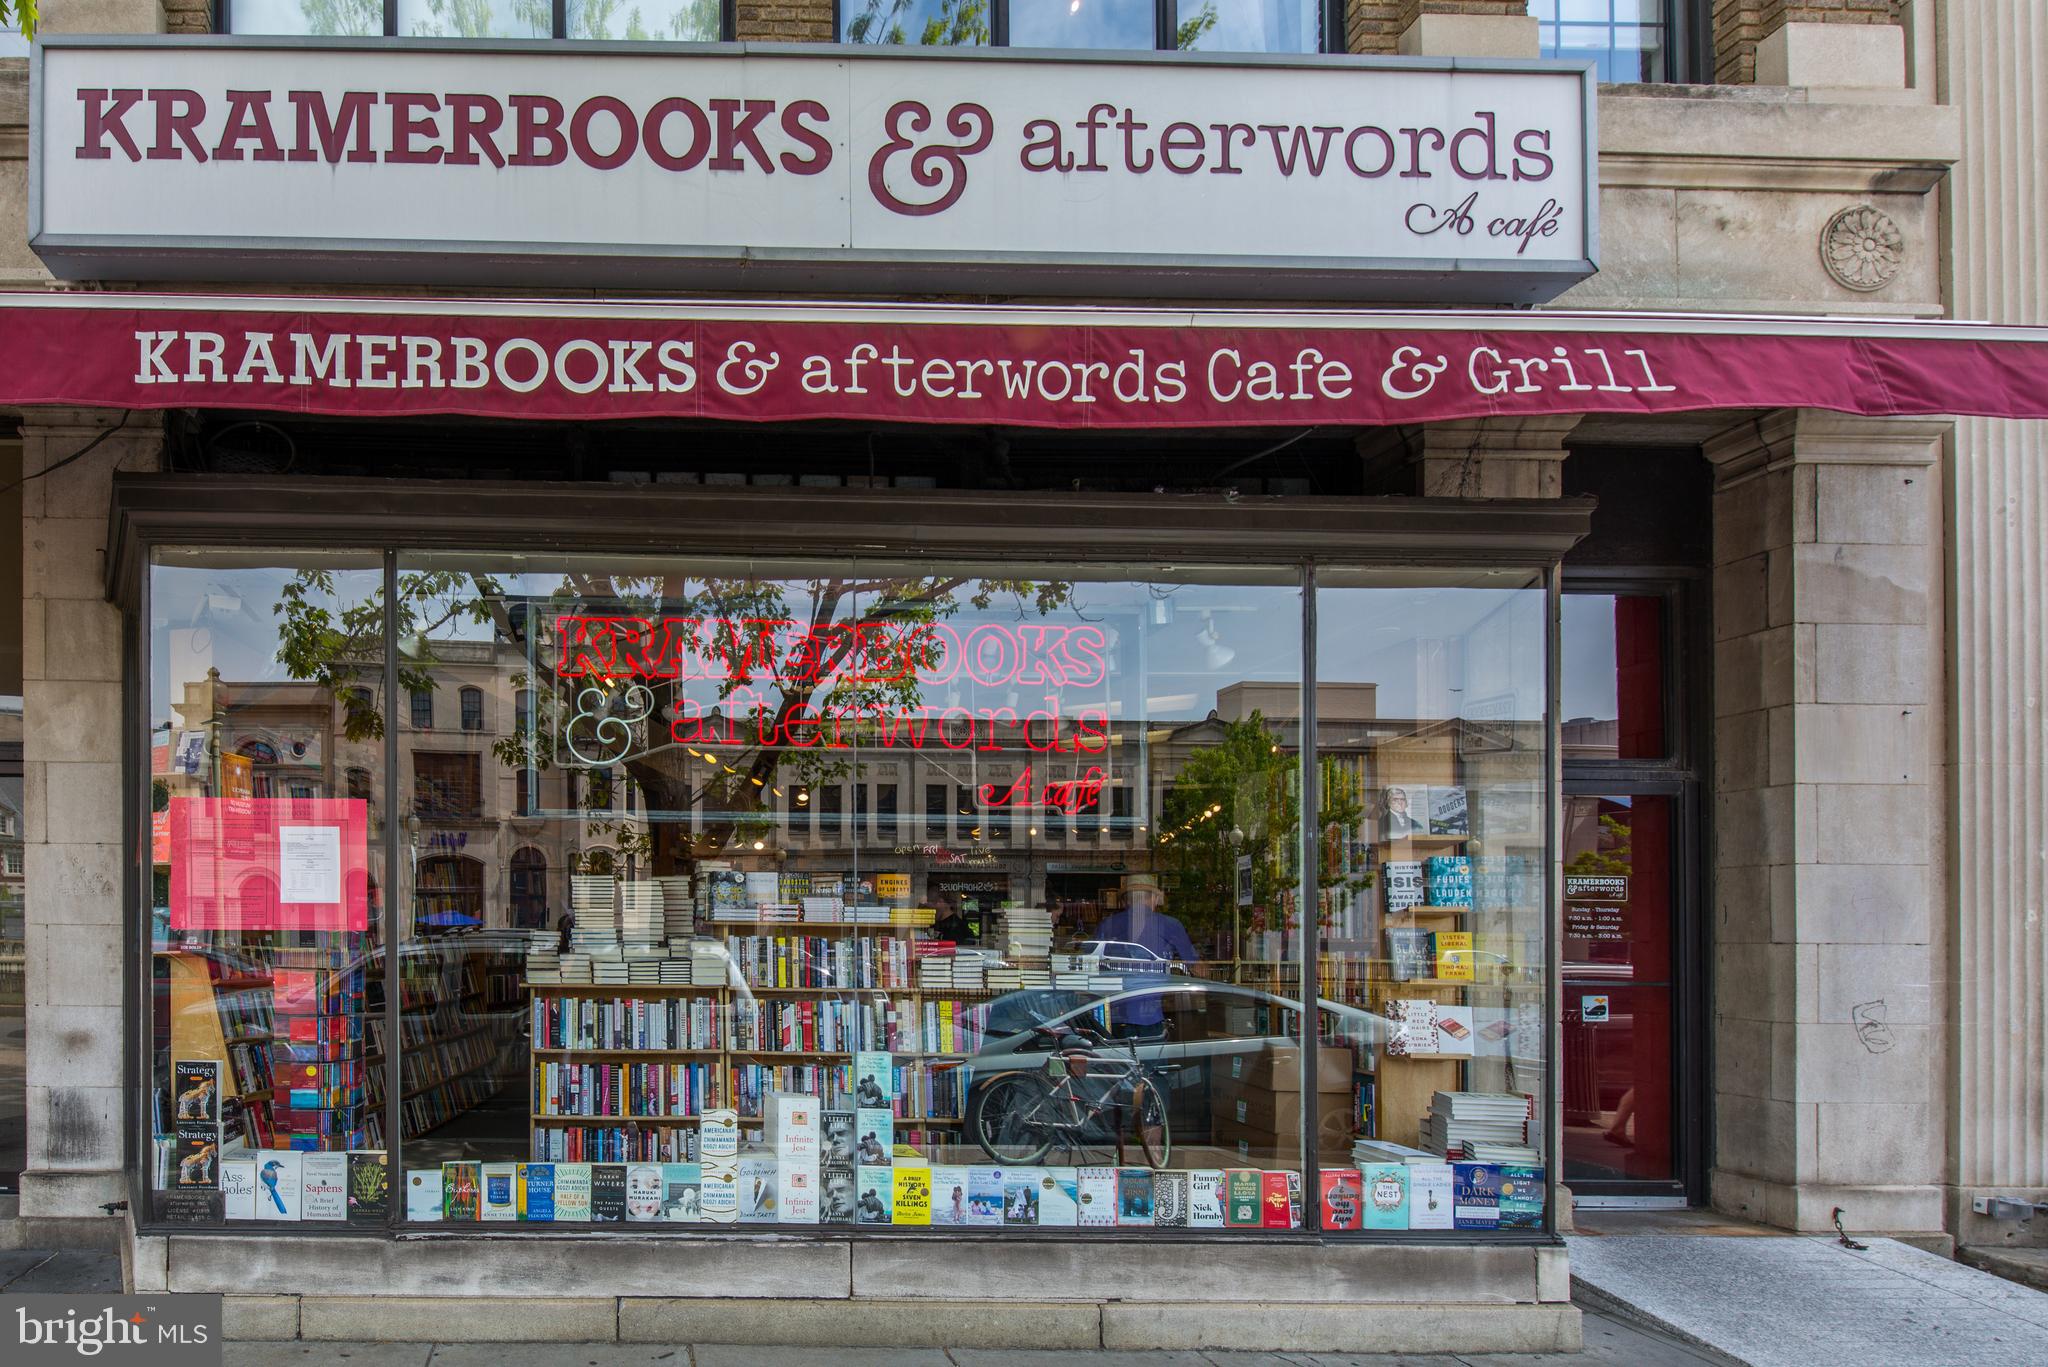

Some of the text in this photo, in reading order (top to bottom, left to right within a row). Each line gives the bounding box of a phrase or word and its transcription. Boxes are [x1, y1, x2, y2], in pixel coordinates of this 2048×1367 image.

[75, 88, 1554, 216] KRAMERBOOKS & afterwords
[1404, 191, 1562, 253] A café
[134, 329, 1677, 403] KRAMERBOOKS & afterwords Cafe & Grill
[556, 616, 1105, 687] KRAMERBOOKS
[565, 683, 1109, 767] & afterwords
[979, 766, 1109, 815] A café
[895, 845, 919, 855] open
[949, 853, 967, 864] SAT
[1388, 876, 1424, 888] ISIS
[1567, 878, 1625, 886] KRAMERBOOKS
[177, 1064, 216, 1078] Strategy
[178, 1129, 217, 1142] Strategy
[785, 1134, 814, 1143] Infinite
[791, 1144, 806, 1153] Jest
[222, 1169, 246, 1182] Ass-
[1193, 1174, 1220, 1183] Funny
[305, 1184, 343, 1195] Sapiens
[1462, 1187, 1495, 1195] DARK
[784, 1197, 814, 1206] Infinite
[1158, 1178, 1185, 1220] J
[1459, 1197, 1496, 1206] MONEY
[791, 1207, 806, 1215] Jest
[1193, 1212, 1223, 1221] Hornby
